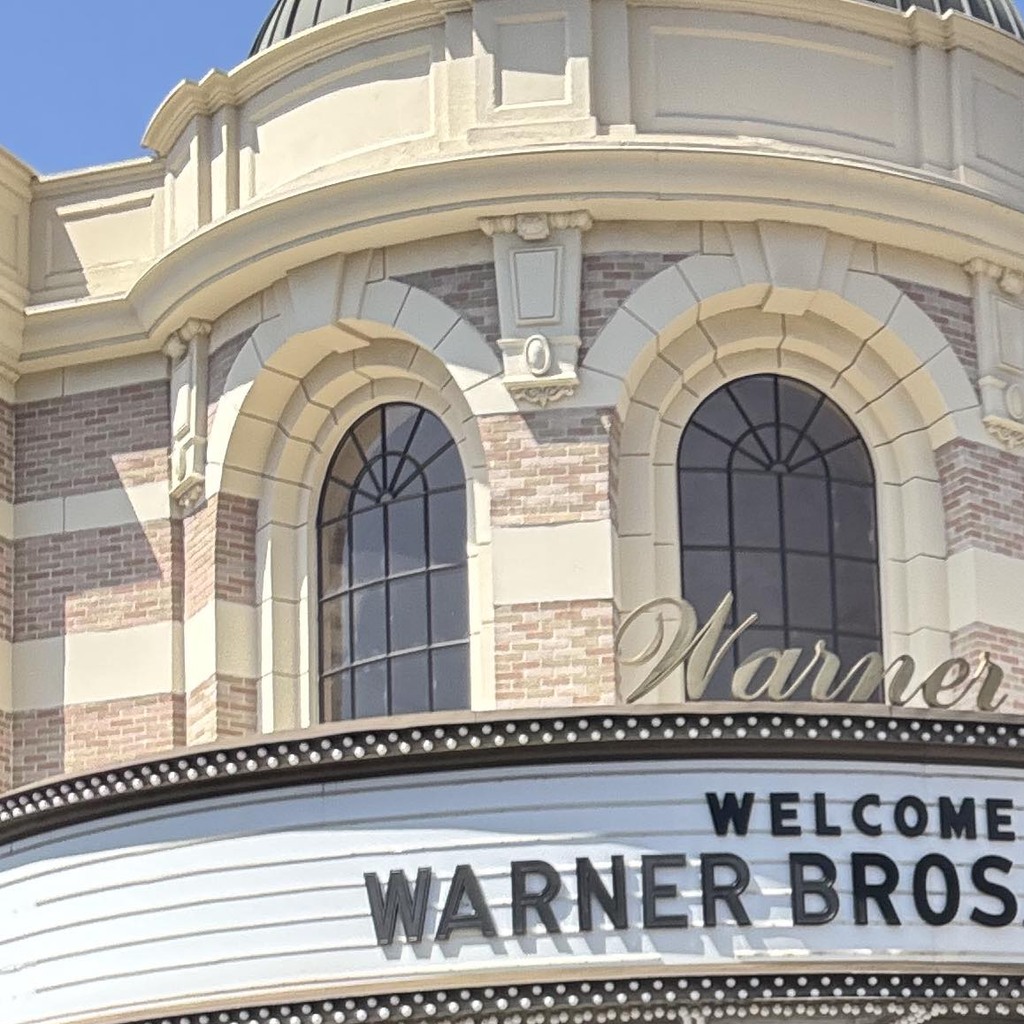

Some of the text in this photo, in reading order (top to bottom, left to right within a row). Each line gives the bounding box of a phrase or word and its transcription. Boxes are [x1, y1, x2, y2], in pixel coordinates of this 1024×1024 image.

[615, 591, 1009, 711] Warner
[705, 792, 1015, 842] WELCOME
[363, 852, 752, 945] WARNER
